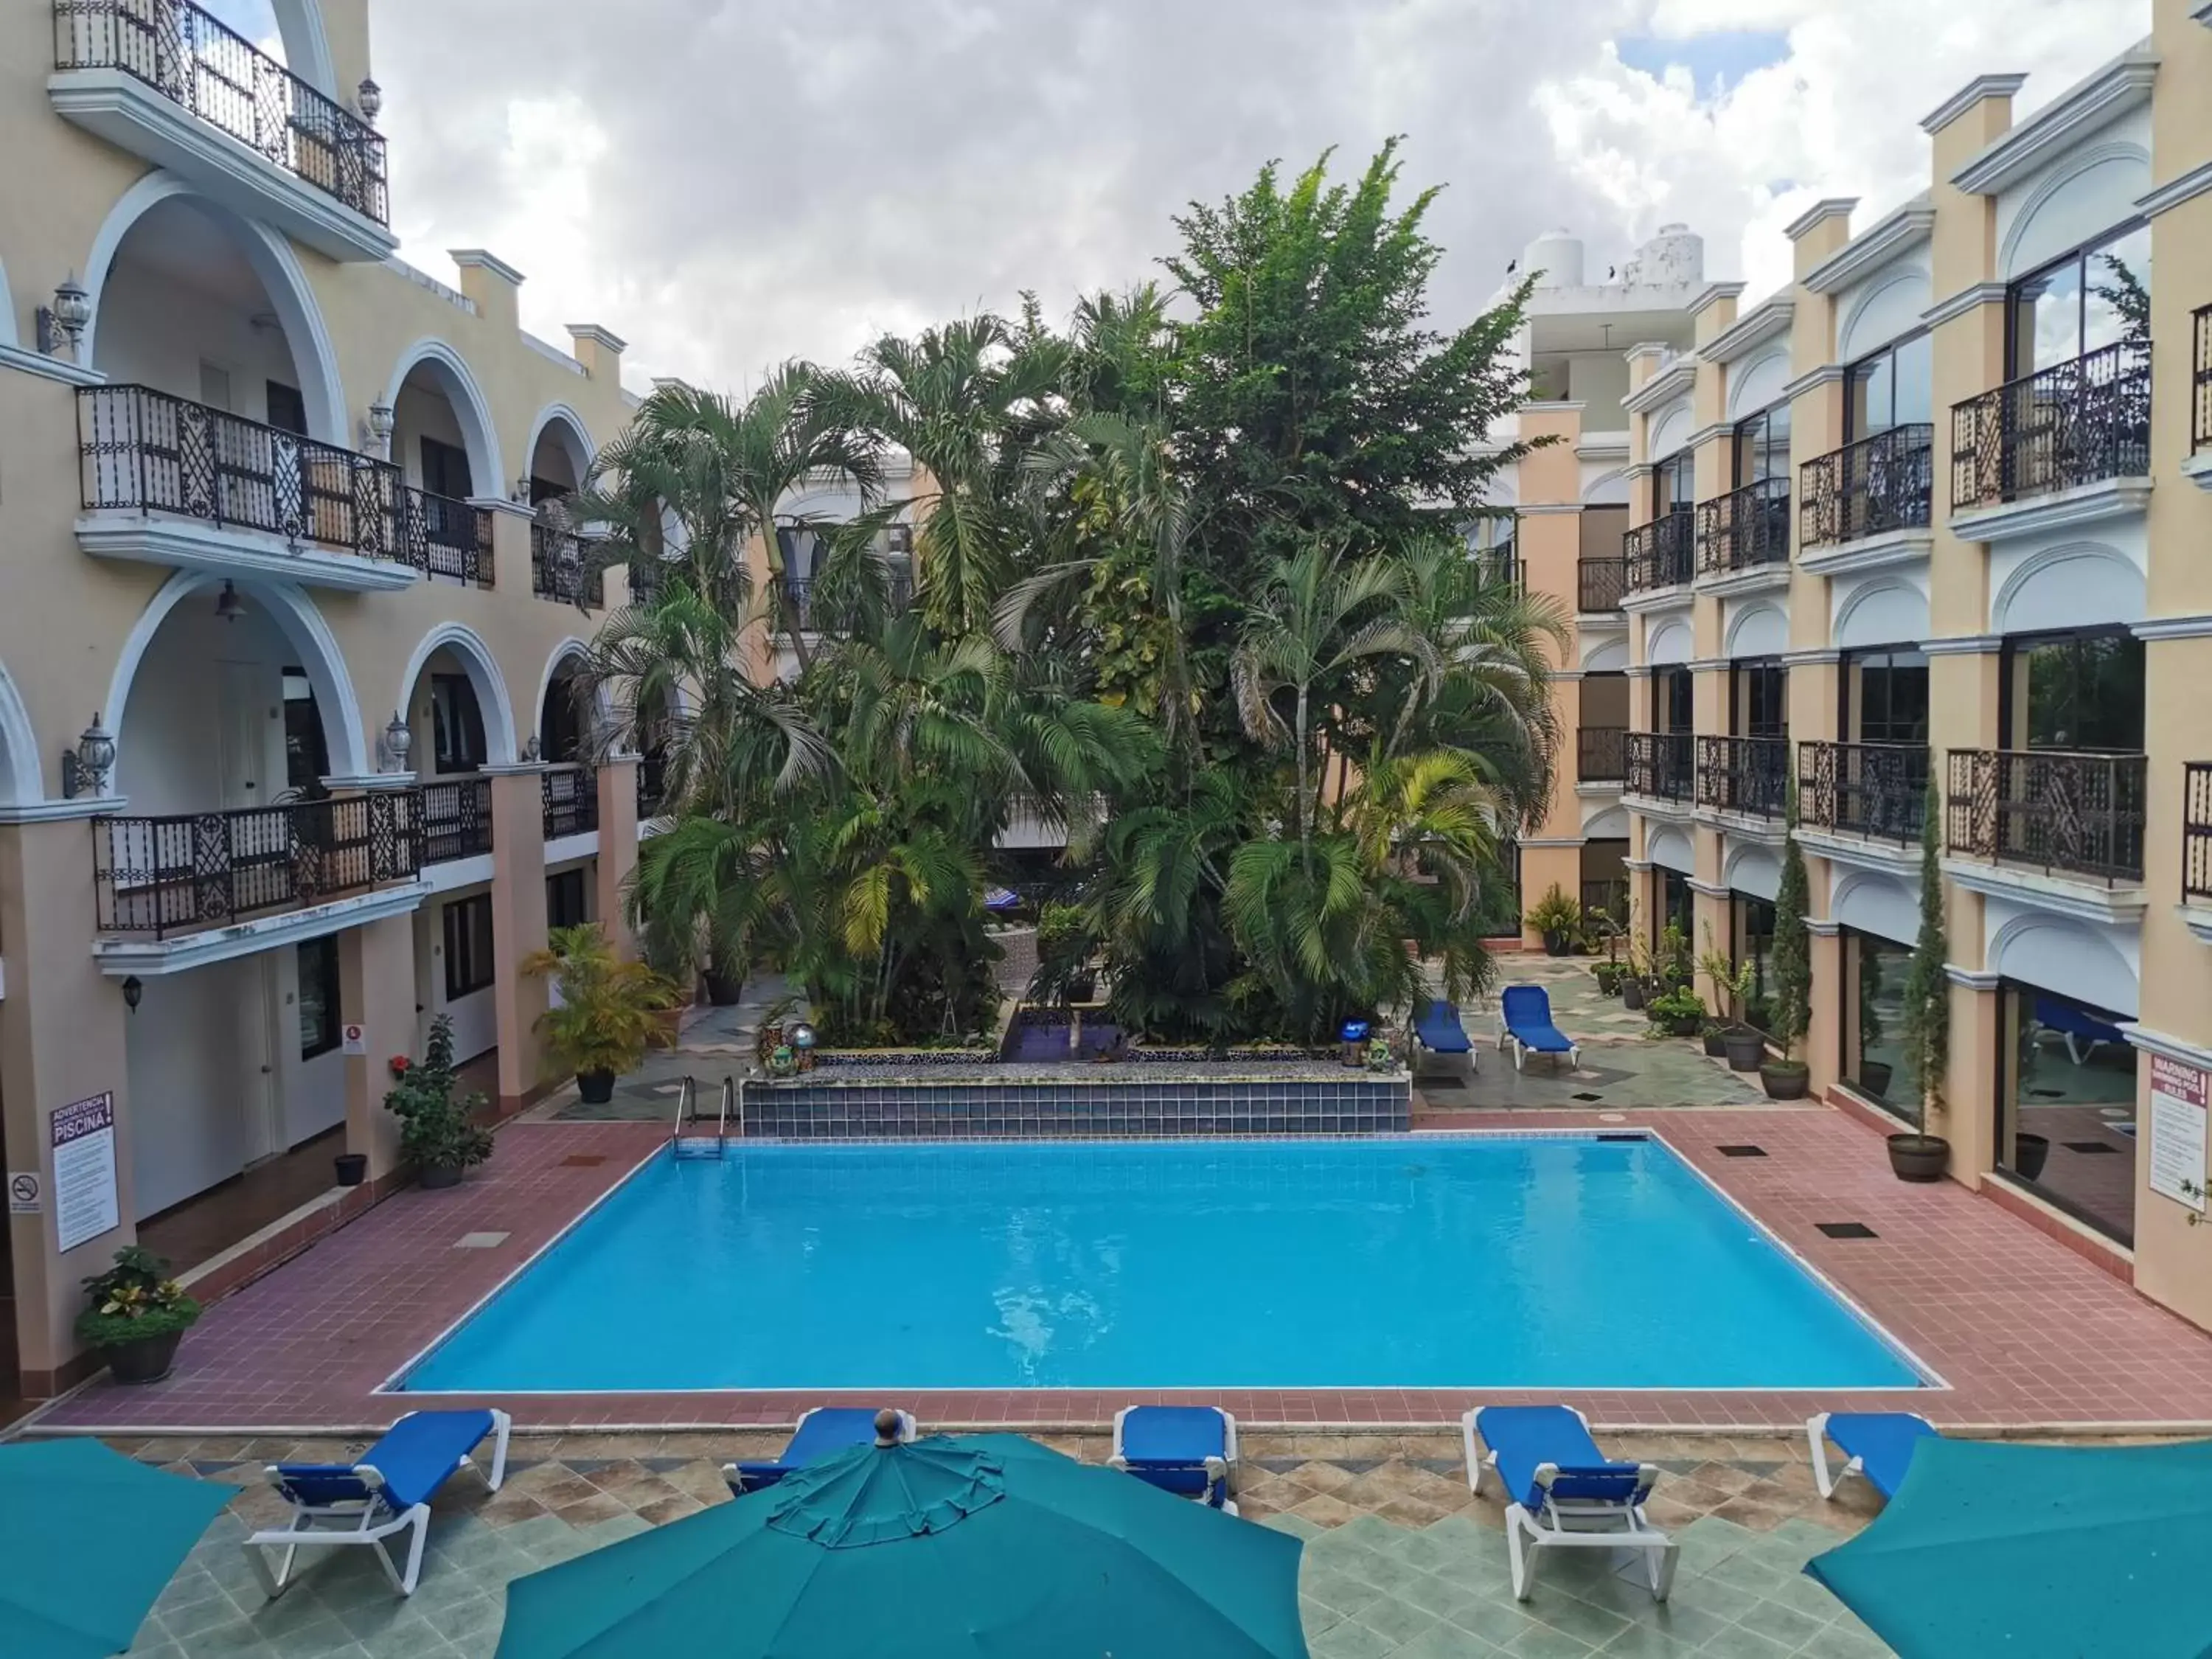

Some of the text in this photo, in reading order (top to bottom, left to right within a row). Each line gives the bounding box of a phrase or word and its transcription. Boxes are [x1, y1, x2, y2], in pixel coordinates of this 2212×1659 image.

[2154, 1057, 2198, 1083] WARNING
[54, 1096, 104, 1121] ADVERTENCIA
[55, 1111, 105, 1143] PISCINA
